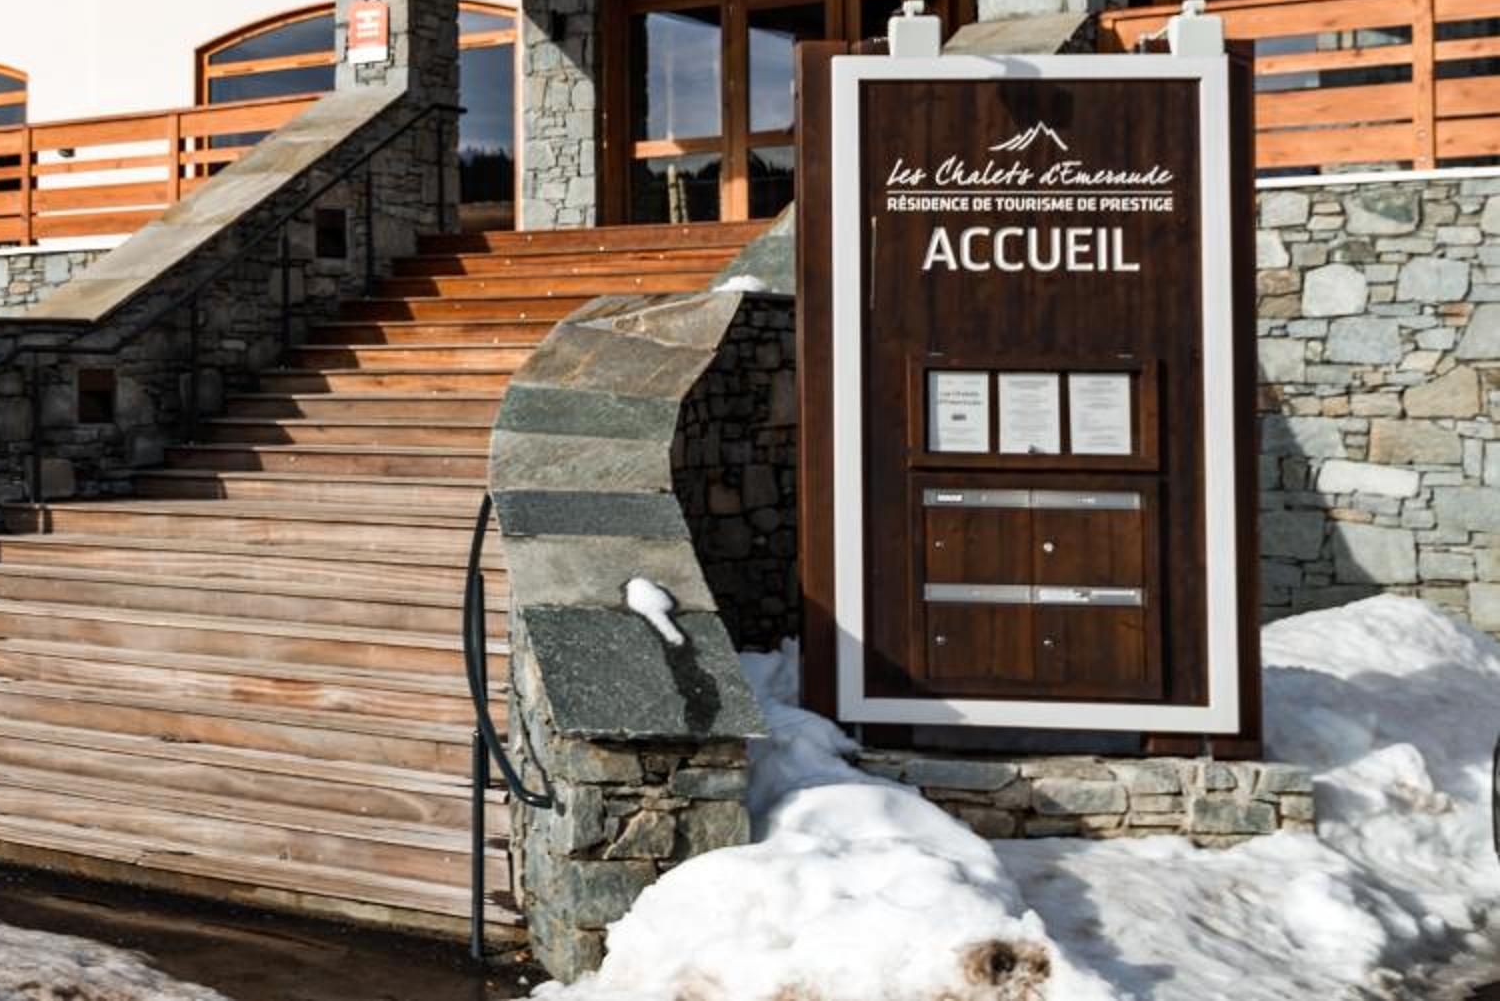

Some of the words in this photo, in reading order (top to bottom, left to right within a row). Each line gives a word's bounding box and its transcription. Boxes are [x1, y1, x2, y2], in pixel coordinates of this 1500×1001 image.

[886, 158, 927, 186] Les
[935, 155, 1034, 186] Chalets
[887, 194, 969, 211] RÉSIDENCE
[972, 197, 992, 211] DE
[995, 197, 1073, 211] TOURISME
[1077, 197, 1097, 211] DE
[1100, 197, 1173, 211] PRESTIGE
[922, 227, 1140, 272] ACCUEIL
